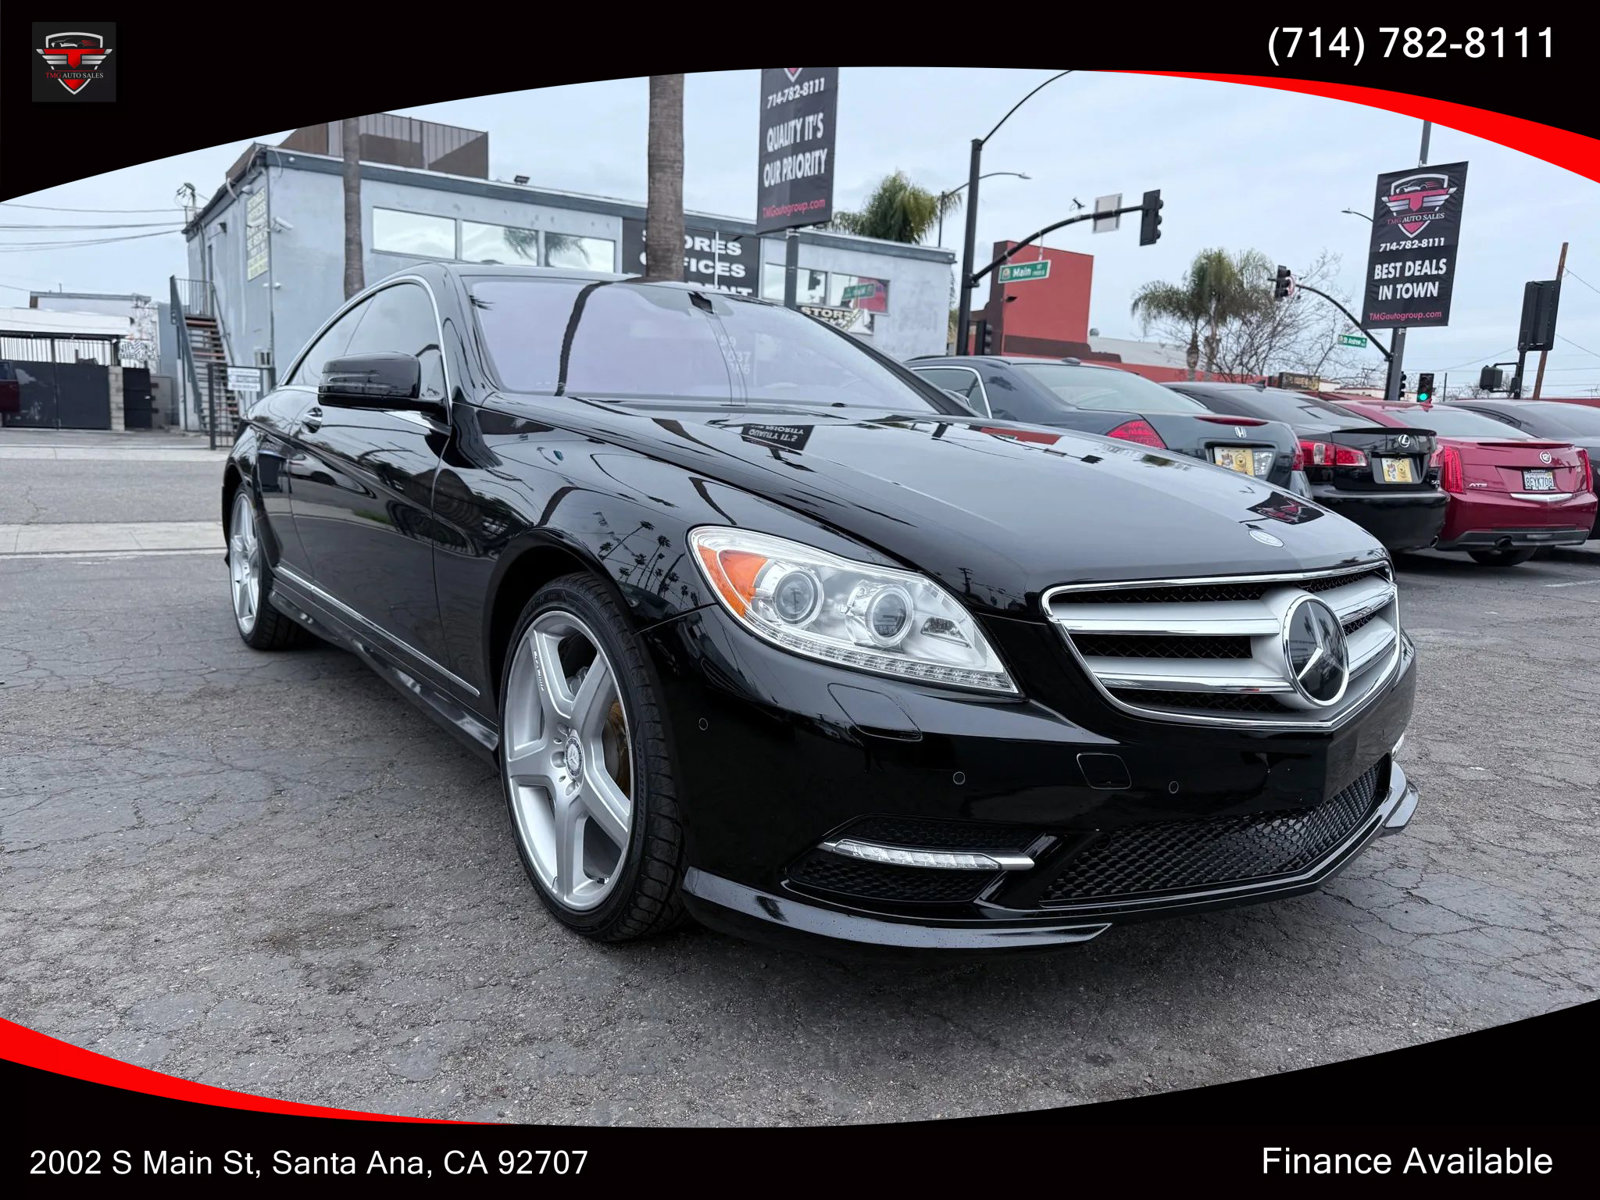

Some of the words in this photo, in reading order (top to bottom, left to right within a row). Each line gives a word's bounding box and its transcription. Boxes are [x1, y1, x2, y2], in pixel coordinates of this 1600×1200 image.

[767, 77, 825, 109] 714-782-8111
[766, 117, 803, 152] QUALITY
[804, 112, 824, 142] IT'S
[763, 162, 781, 188] OUR
[782, 148, 828, 183] PRIORITY
[1402, 214, 1422, 223] AUTO
[1422, 212, 1445, 221] SALES
[1379, 237, 1445, 252] 714-782-8111
[1012, 265, 1032, 278] Main
[1374, 262, 1402, 279] BEST
[1404, 258, 1447, 276] DEALS
[1378, 285, 1393, 301] IN
[1396, 281, 1439, 300] TOWN
[1369, 311, 1442, 321] TMGautogroup.com
